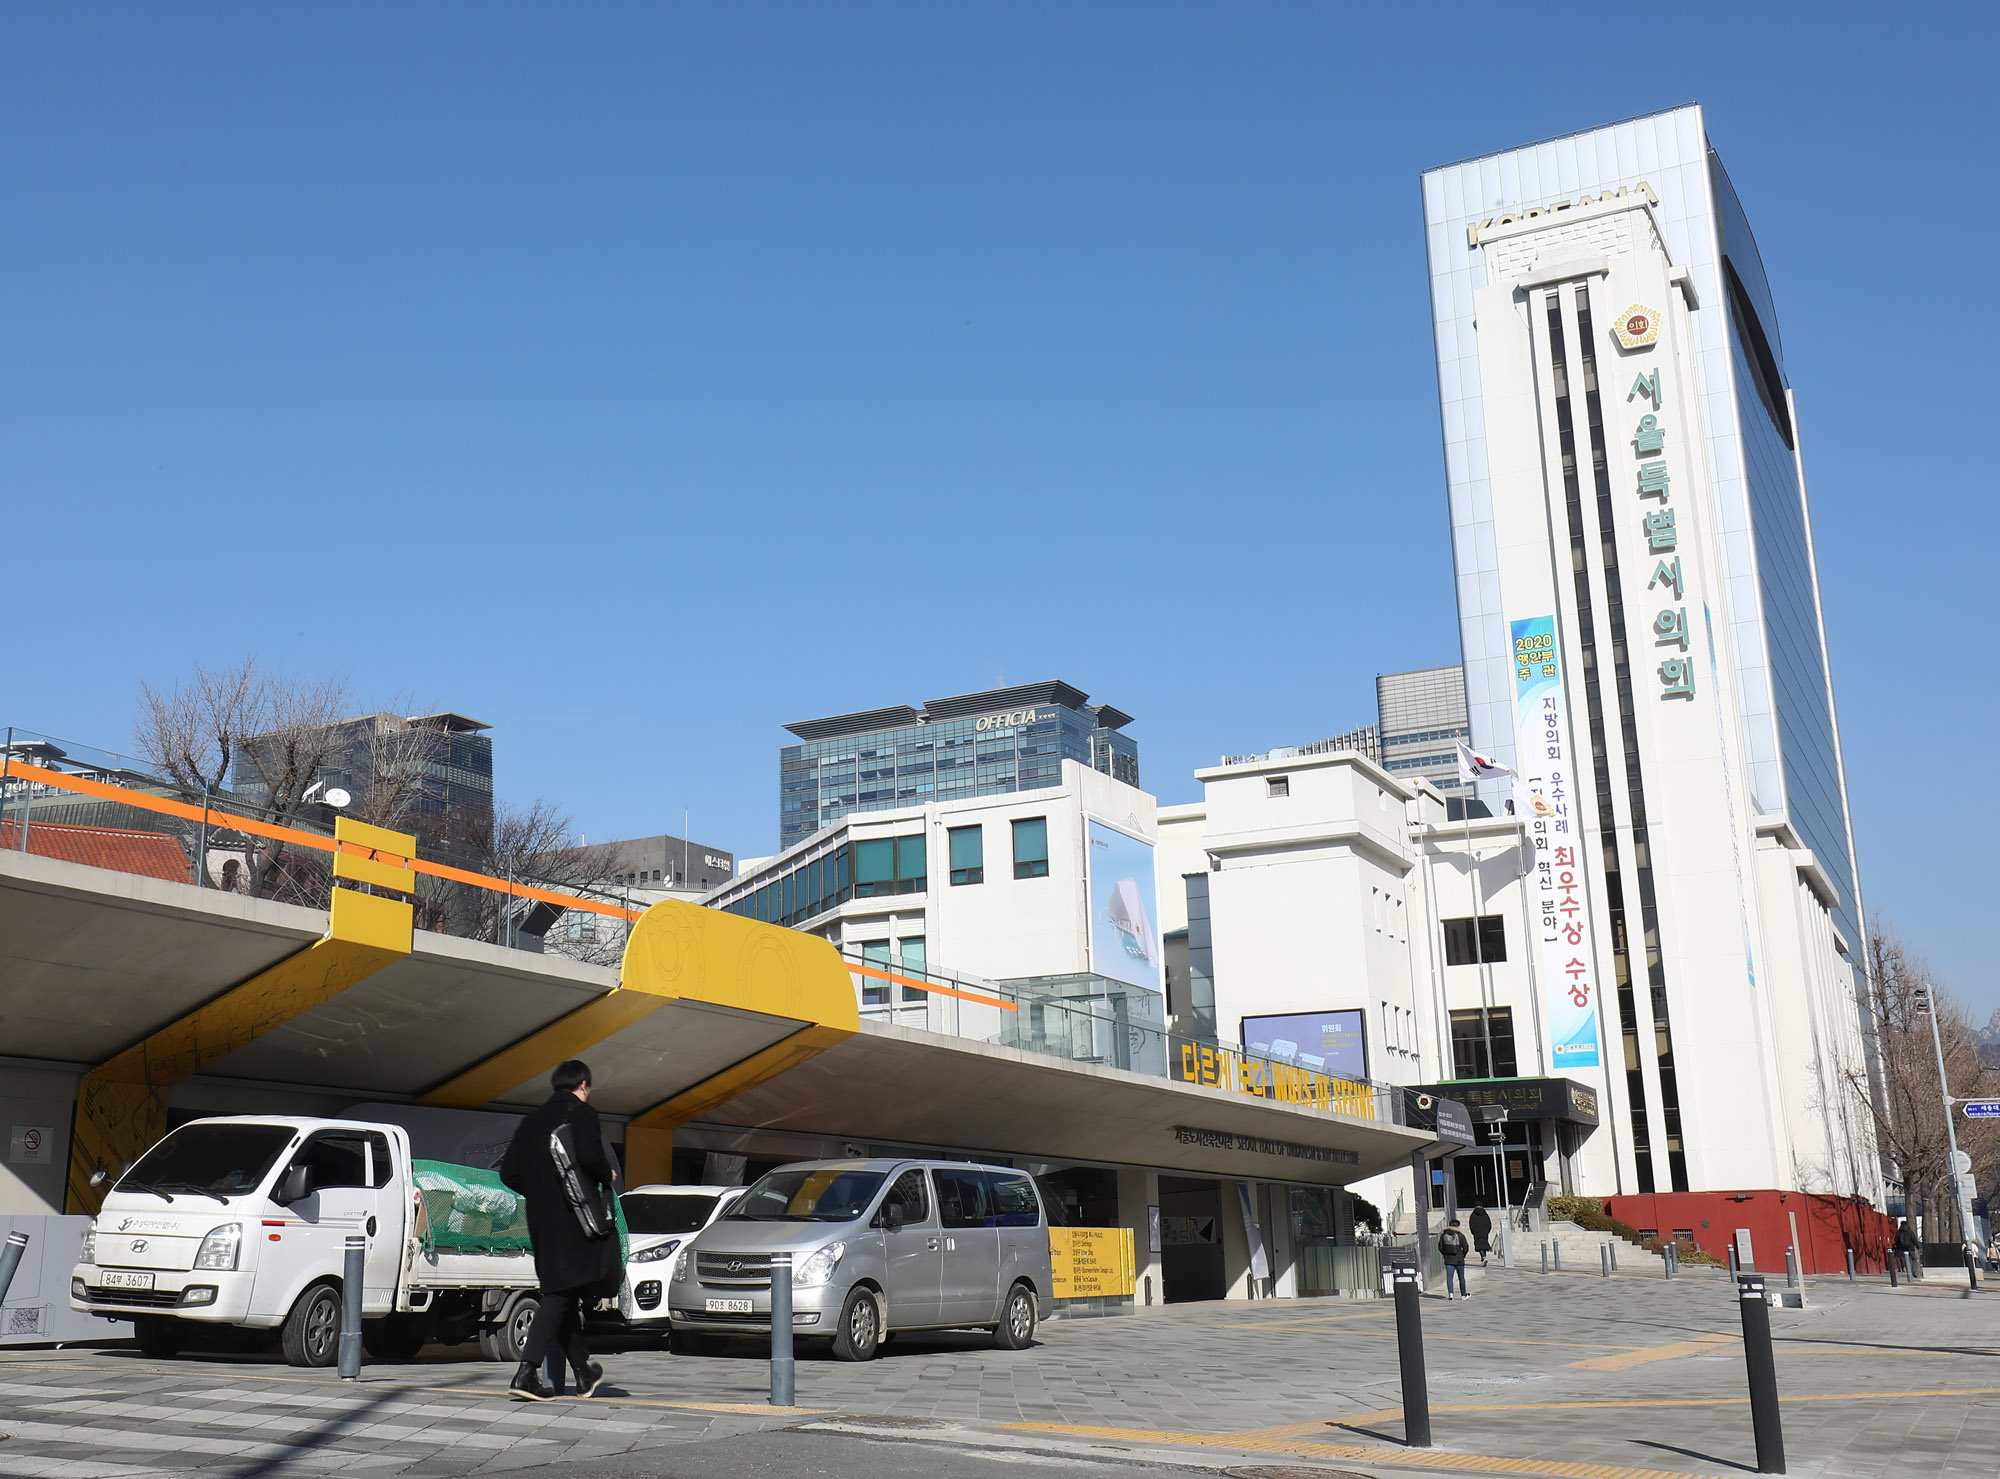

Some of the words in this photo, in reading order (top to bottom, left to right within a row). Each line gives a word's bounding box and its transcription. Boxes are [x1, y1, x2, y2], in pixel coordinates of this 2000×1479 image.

[1628, 319, 1648, 331] 의회
[1630, 367, 1697, 695] 서울특별시의회
[1515, 634, 1553, 652] 2020
[1517, 650, 1554, 667] 행안부
[975, 709, 1036, 732] OFFICIA
[1542, 697, 1561, 760] 지방의회
[1550, 772, 1569, 834] 우수사례
[1537, 861, 1553, 891] 혁신
[1554, 846, 1584, 946] 최우수상
[1565, 958, 1590, 1008] 수상
[1181, 1041, 1233, 1092] 다르게
[1237, 1053, 1267, 1098] 보다
[1271, 1061, 1313, 1108] WAYS
[1314, 1074, 1331, 1113] OF
[1332, 1076, 1375, 1121] SEEING
[105, 1273, 123, 1286] 84부
[125, 1274, 149, 1287] 3607
[709, 1300, 725, 1310] 90조
[727, 1301, 749, 1311] 8628
